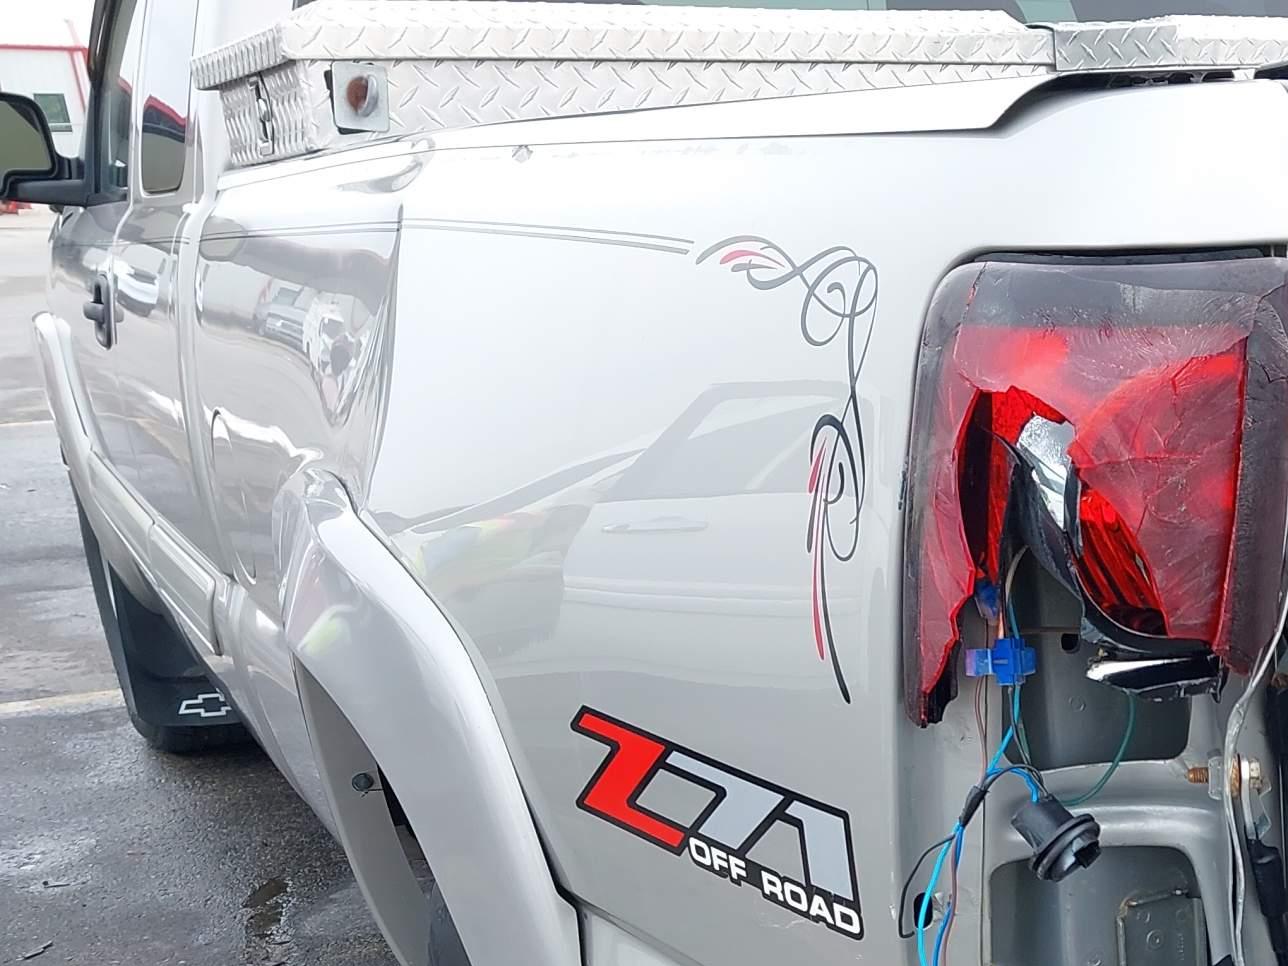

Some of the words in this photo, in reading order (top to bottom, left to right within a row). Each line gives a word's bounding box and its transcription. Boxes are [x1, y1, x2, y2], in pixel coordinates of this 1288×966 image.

[571, 705, 857, 902] Z71
[688, 837, 747, 880] OFF
[760, 870, 862, 935] ROAD
